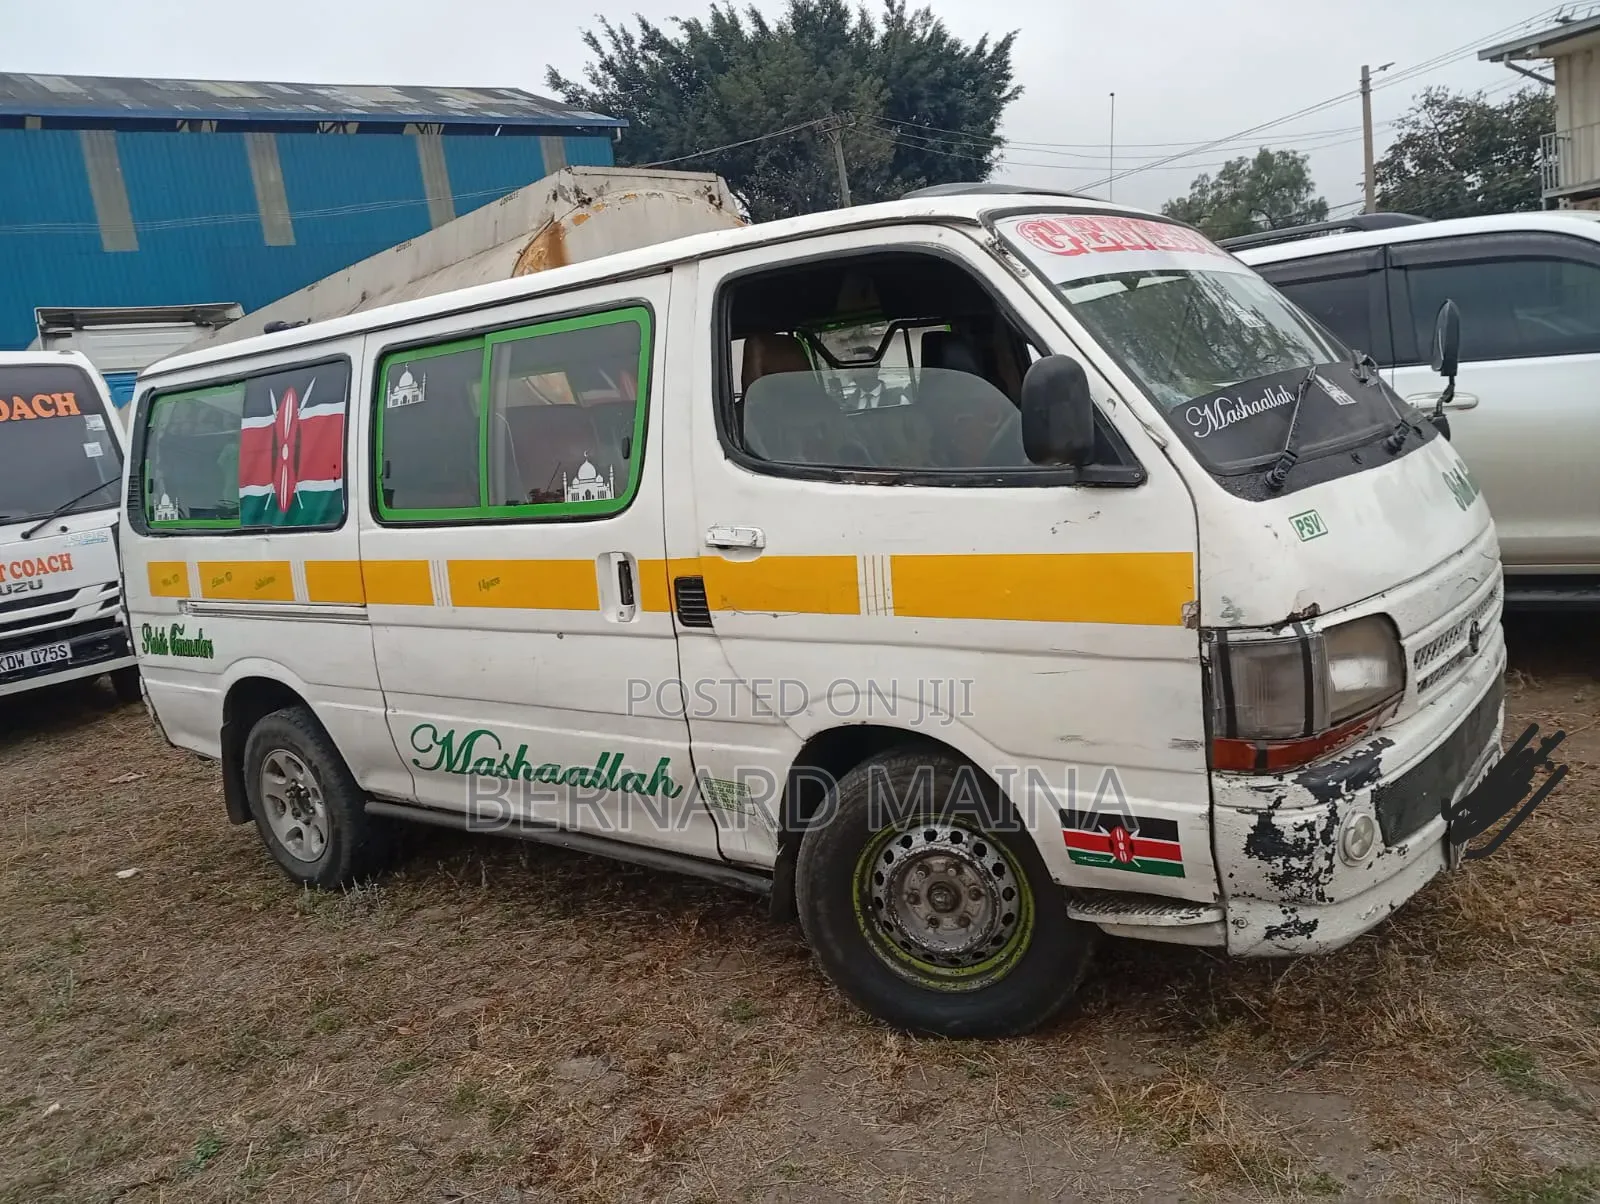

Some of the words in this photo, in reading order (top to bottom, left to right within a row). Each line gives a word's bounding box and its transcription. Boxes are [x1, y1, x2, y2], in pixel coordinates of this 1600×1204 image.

[1185, 385, 1295, 438] Mashaallah
[1295, 513, 1321, 538] PSV
[9, 553, 74, 579] COACH
[31, 644, 68, 664] 075S
[410, 723, 683, 799] Mashaallah
